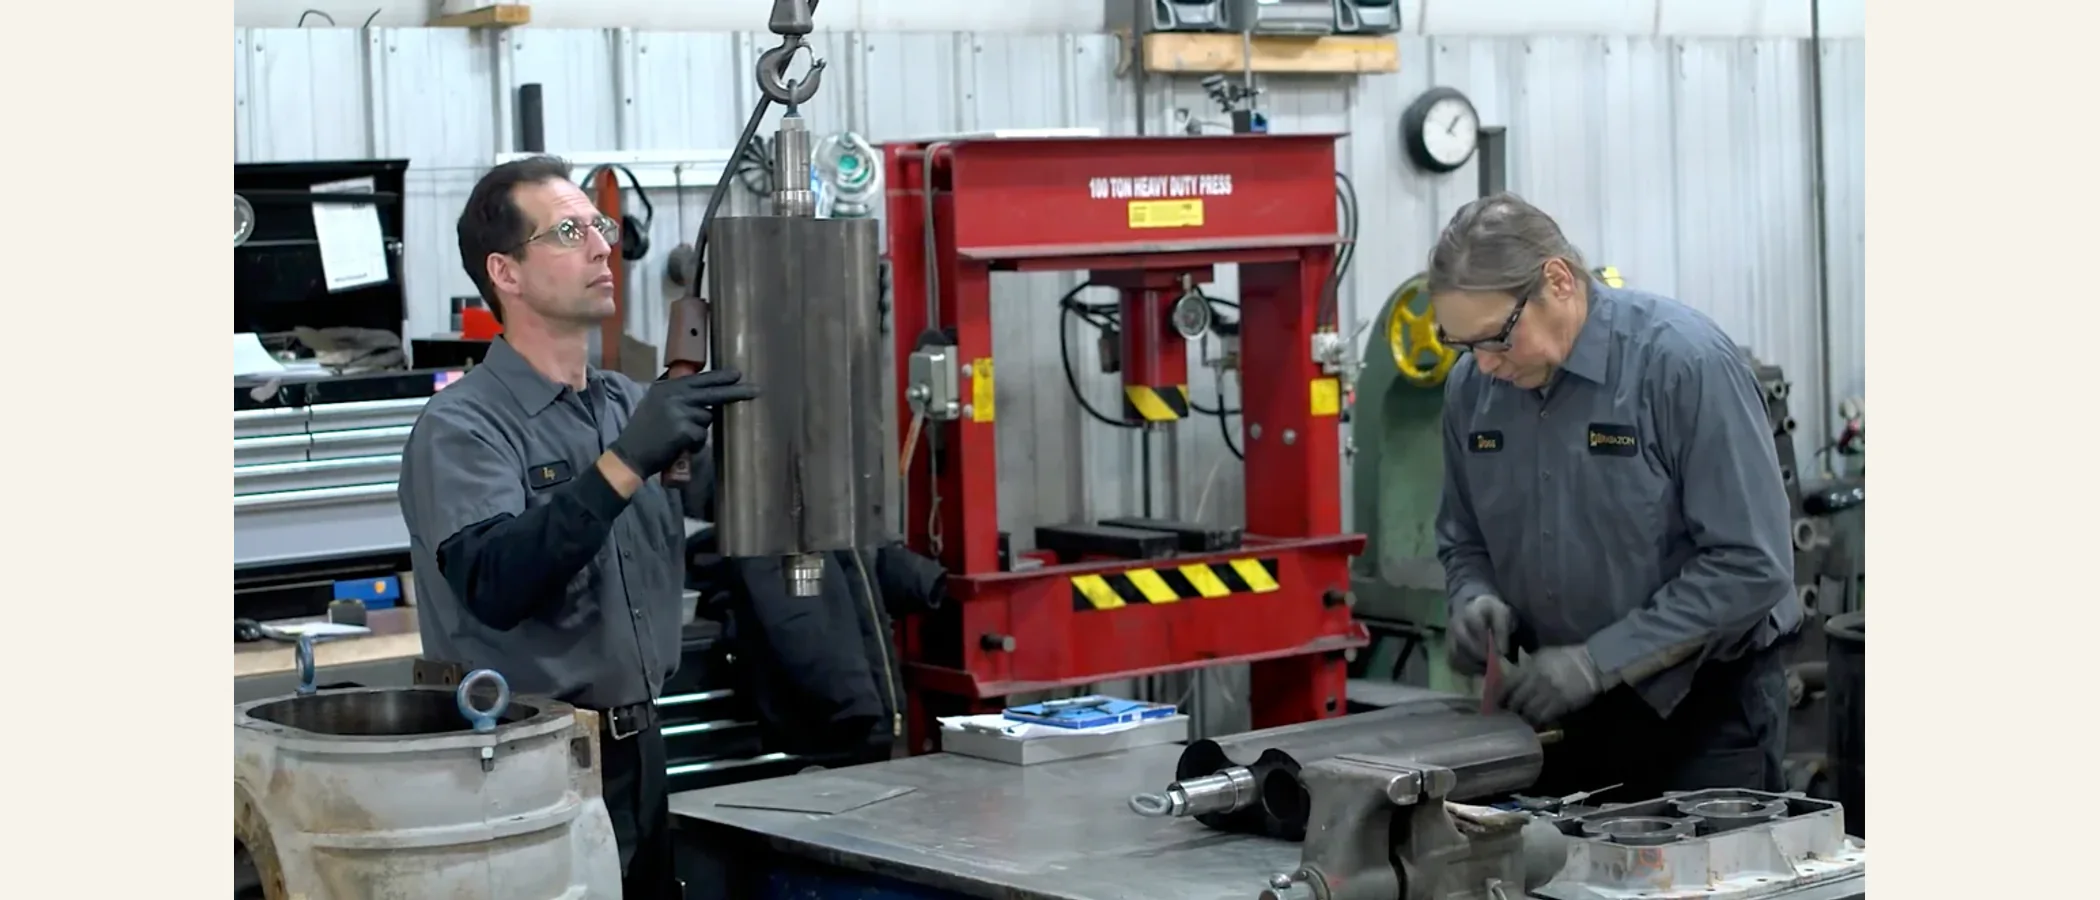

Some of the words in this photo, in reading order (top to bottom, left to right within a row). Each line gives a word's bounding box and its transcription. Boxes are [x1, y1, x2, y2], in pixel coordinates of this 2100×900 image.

[1089, 177, 1108, 198] 100
[1110, 177, 1132, 198] TON
[1133, 175, 1168, 197] HEAVY
[1170, 174, 1198, 197] DUTY
[1199, 174, 1232, 195] PRESS
